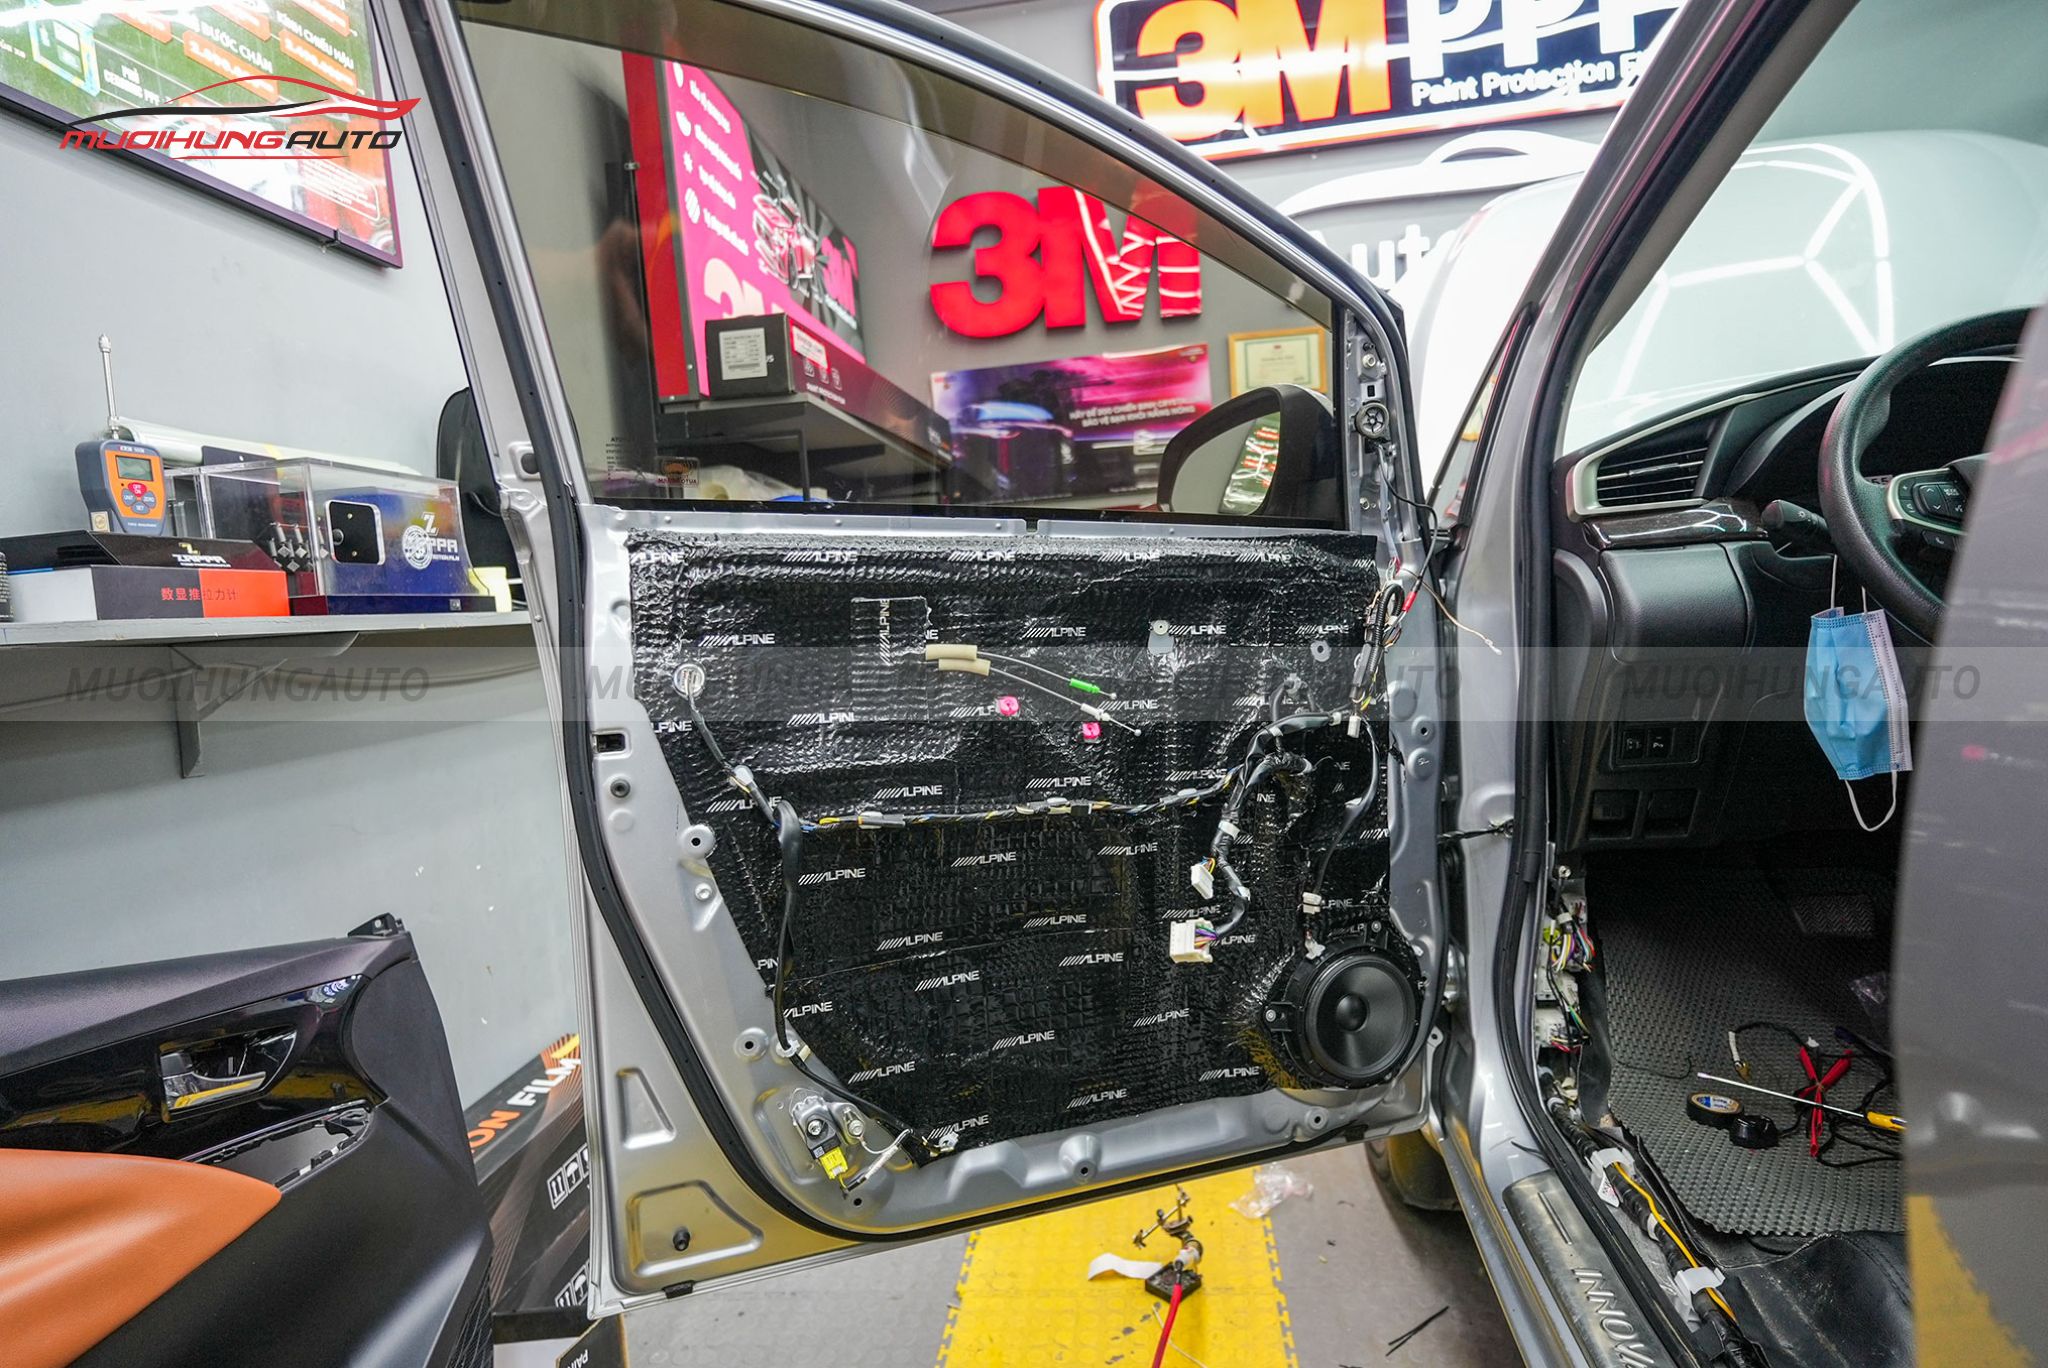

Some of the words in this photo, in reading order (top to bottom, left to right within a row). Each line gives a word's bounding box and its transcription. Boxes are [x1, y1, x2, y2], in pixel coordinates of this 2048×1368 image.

[1136, 0, 1392, 141] 3M
[1411, 76, 1479, 107] Paint
[1482, 58, 1615, 98] Protection
[930, 186, 1202, 338] 3M
[973, 552, 1016, 561] ALPINE
[1046, 627, 1086, 637] ALPINE
[1187, 625, 1226, 635] ALPINE
[725, 634, 775, 646] ALPINE
[1120, 700, 1158, 709] ALPINE
[650, 720, 692, 733] LPINE
[1050, 776, 1091, 788] ALPINE
[896, 785, 943, 798] ALPINE
[1121, 842, 1158, 855] ALPINE
[974, 852, 1016, 865] ALPINE
[822, 868, 866, 882] ALPINE
[1046, 914, 1087, 925] ALPINE
[901, 932, 943, 947] ALPINE
[1082, 953, 1124, 964] ALPINE
[938, 971, 980, 987] ALPINE
[789, 1002, 833, 1017] ALPINE
[1154, 1008, 1189, 1023] ALPINE
[1016, 1031, 1055, 1046] ALPINE
[874, 1061, 915, 1078] ALPINE
[1220, 1066, 1260, 1077] ALPINE
[1089, 1089, 1127, 1103] ALPINE
